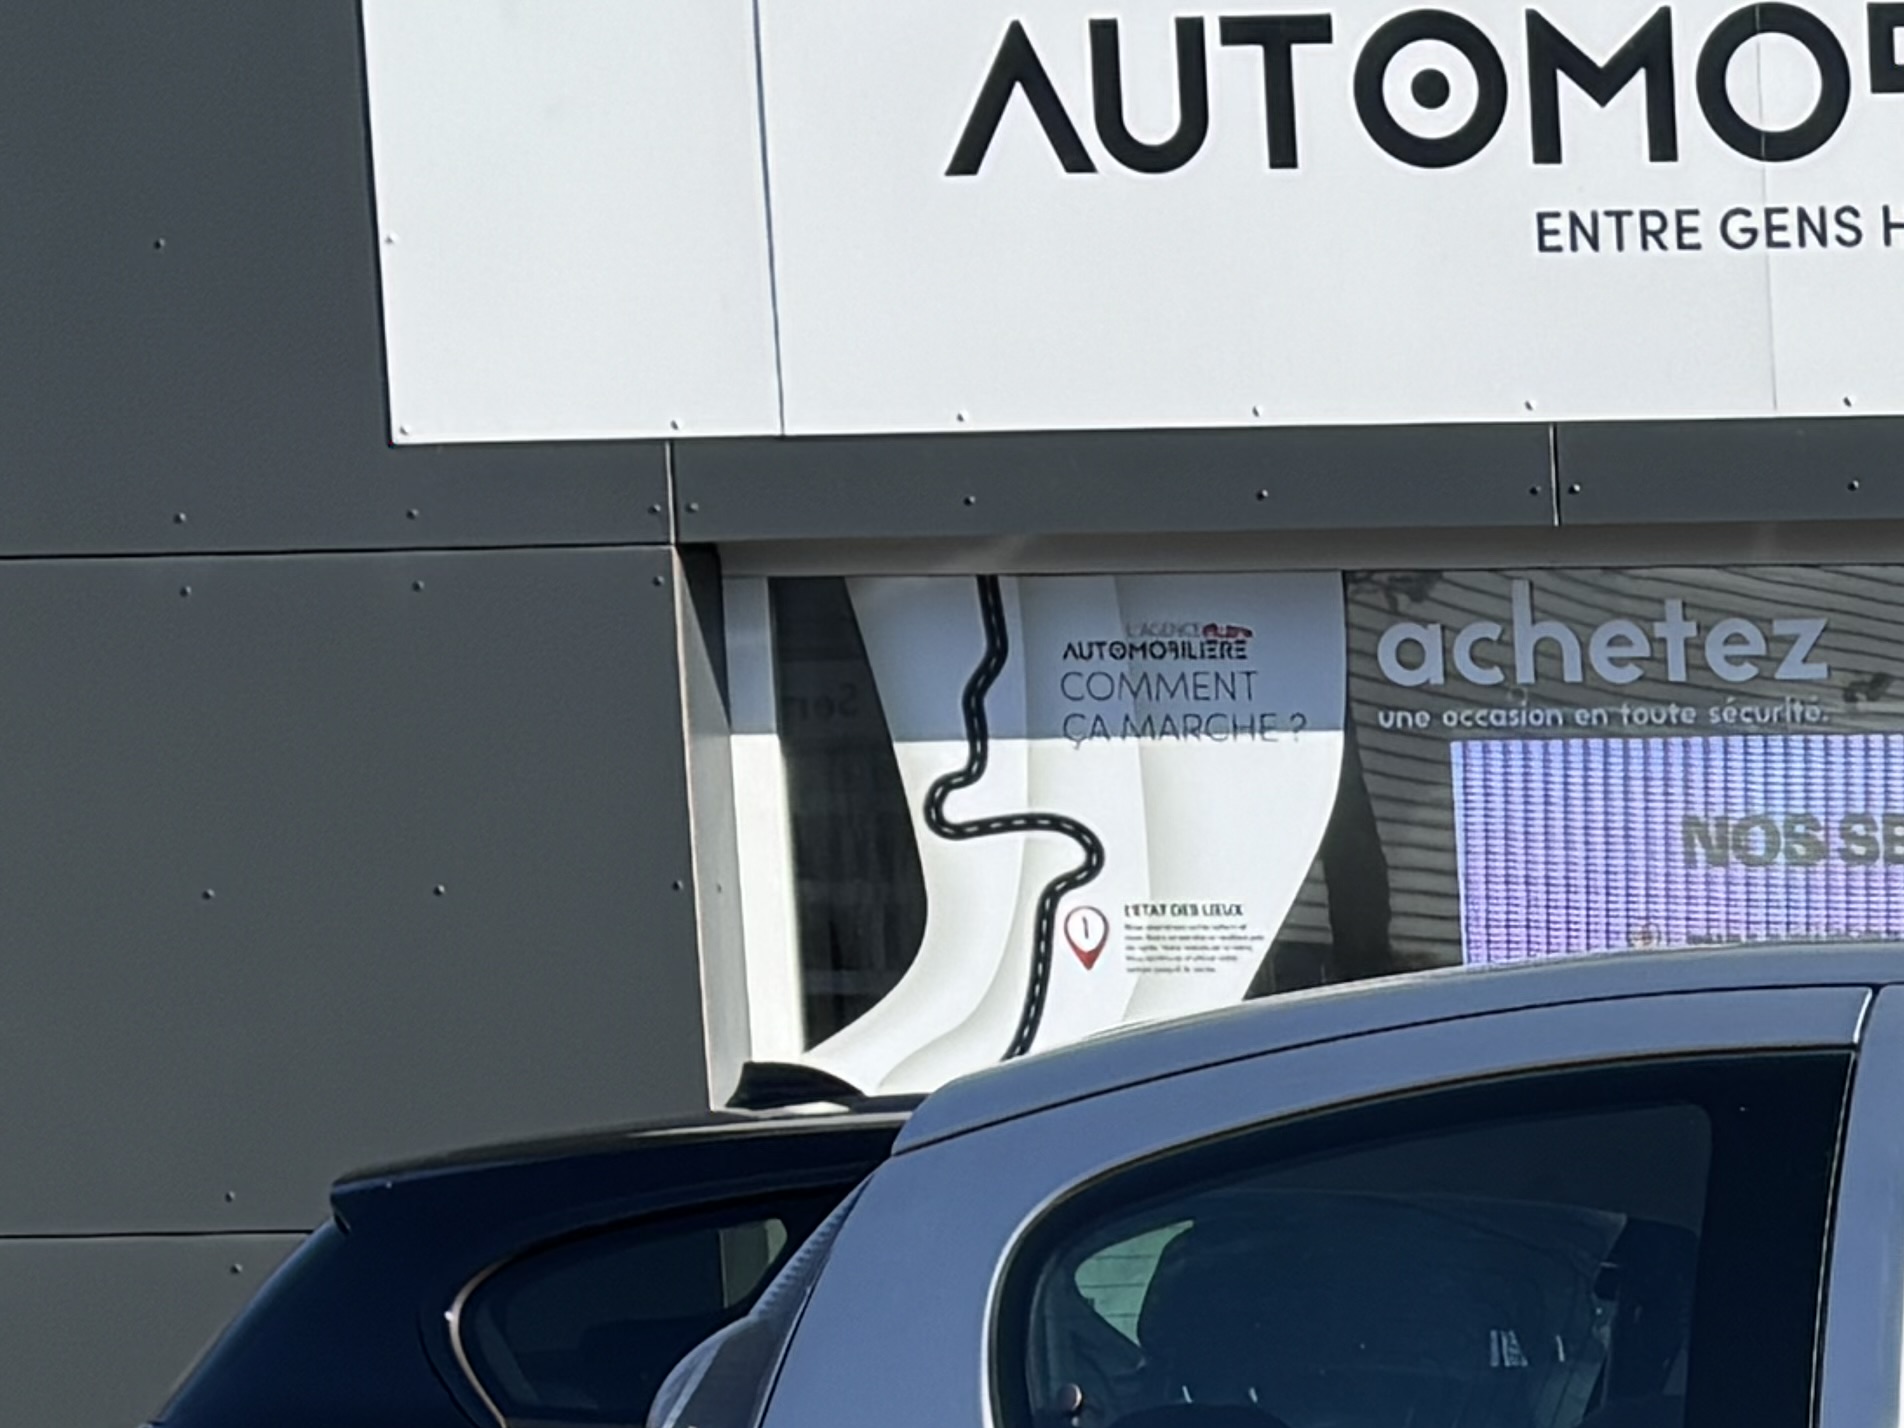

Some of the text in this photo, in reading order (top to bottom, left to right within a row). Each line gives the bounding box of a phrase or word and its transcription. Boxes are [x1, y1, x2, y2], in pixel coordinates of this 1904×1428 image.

[1536, 208, 1702, 253] ENTRE
[1719, 205, 1863, 250] GENS
[1376, 579, 1831, 688] achetez
[1060, 670, 1260, 702] COMMENT
[1062, 711, 1308, 752] ÇA MARCHE ?
[1377, 707, 1432, 730] une
[1442, 701, 1565, 729] occasion
[1574, 704, 1609, 727] en
[1620, 699, 1698, 726] toute
[1680, 811, 1824, 870] NOS
